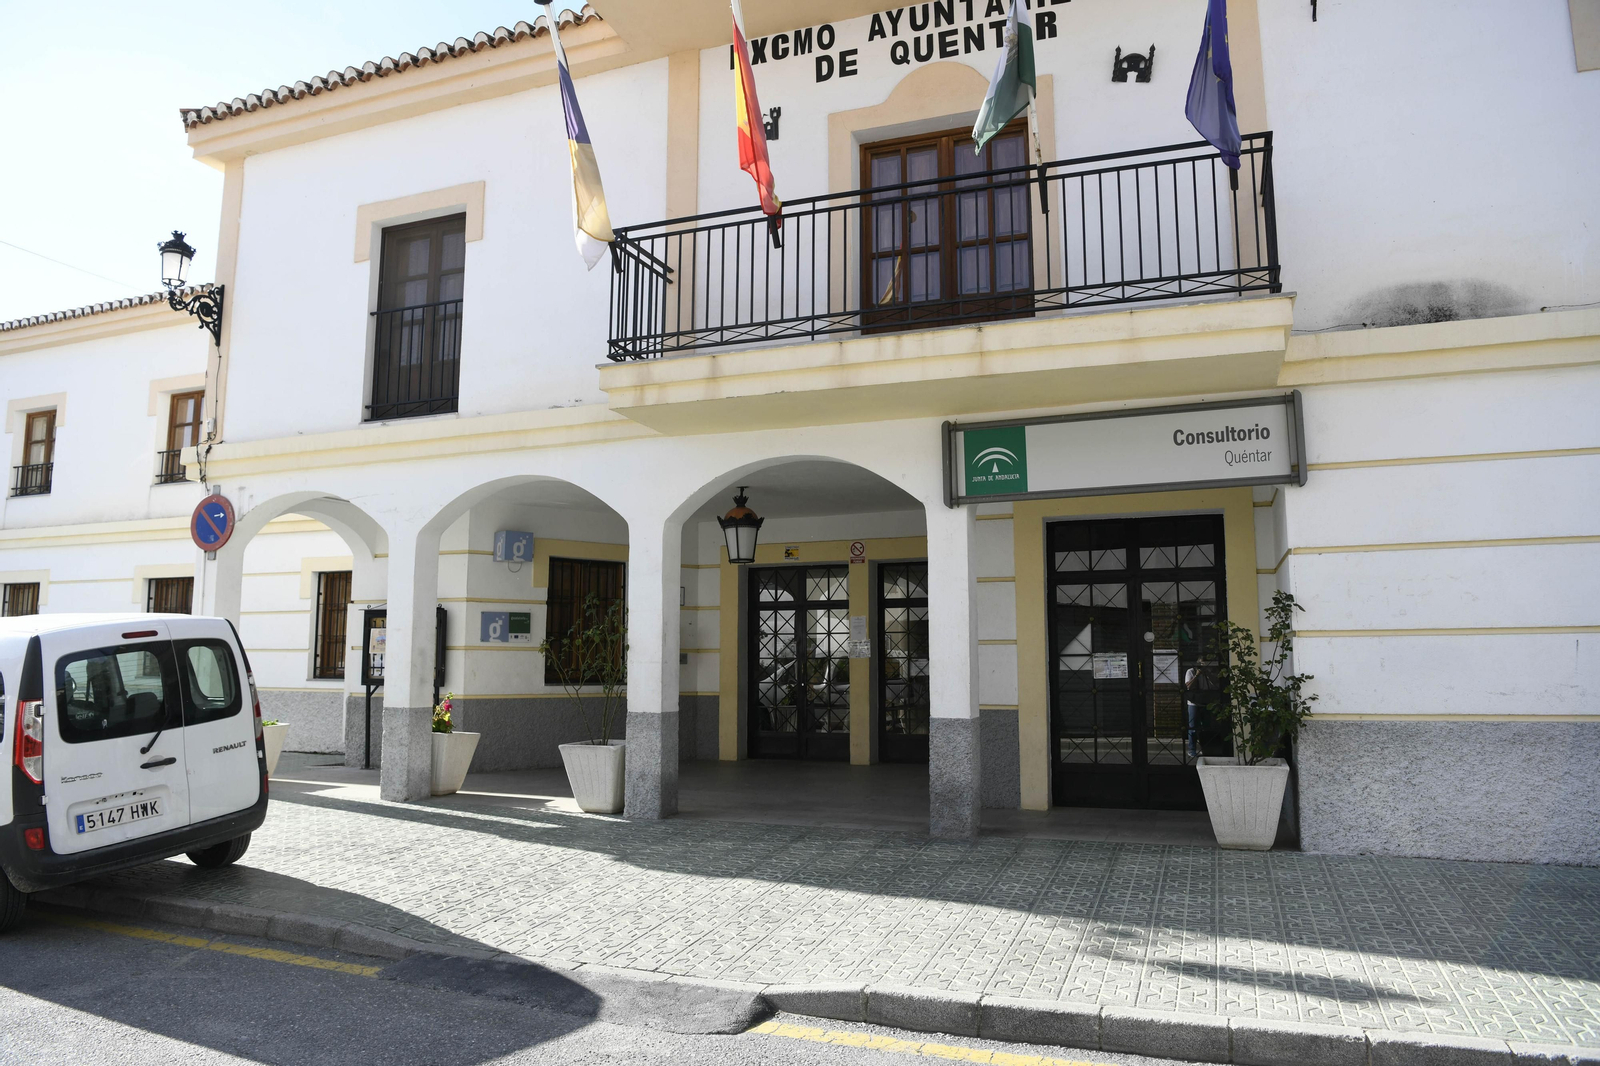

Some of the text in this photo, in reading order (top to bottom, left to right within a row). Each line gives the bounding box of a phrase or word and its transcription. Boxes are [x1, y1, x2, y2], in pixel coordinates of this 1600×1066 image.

[730, 0, 1072, 70] XCMO AYUNTA
[815, 10, 1058, 83] DE QUENTR
[1172, 423, 1270, 447] Consultorio
[1224, 448, 1272, 467] Quéntar
[212, 740, 247, 754] RENAULT
[86, 807, 125, 829] 5147
[130, 800, 159, 820] HWK
